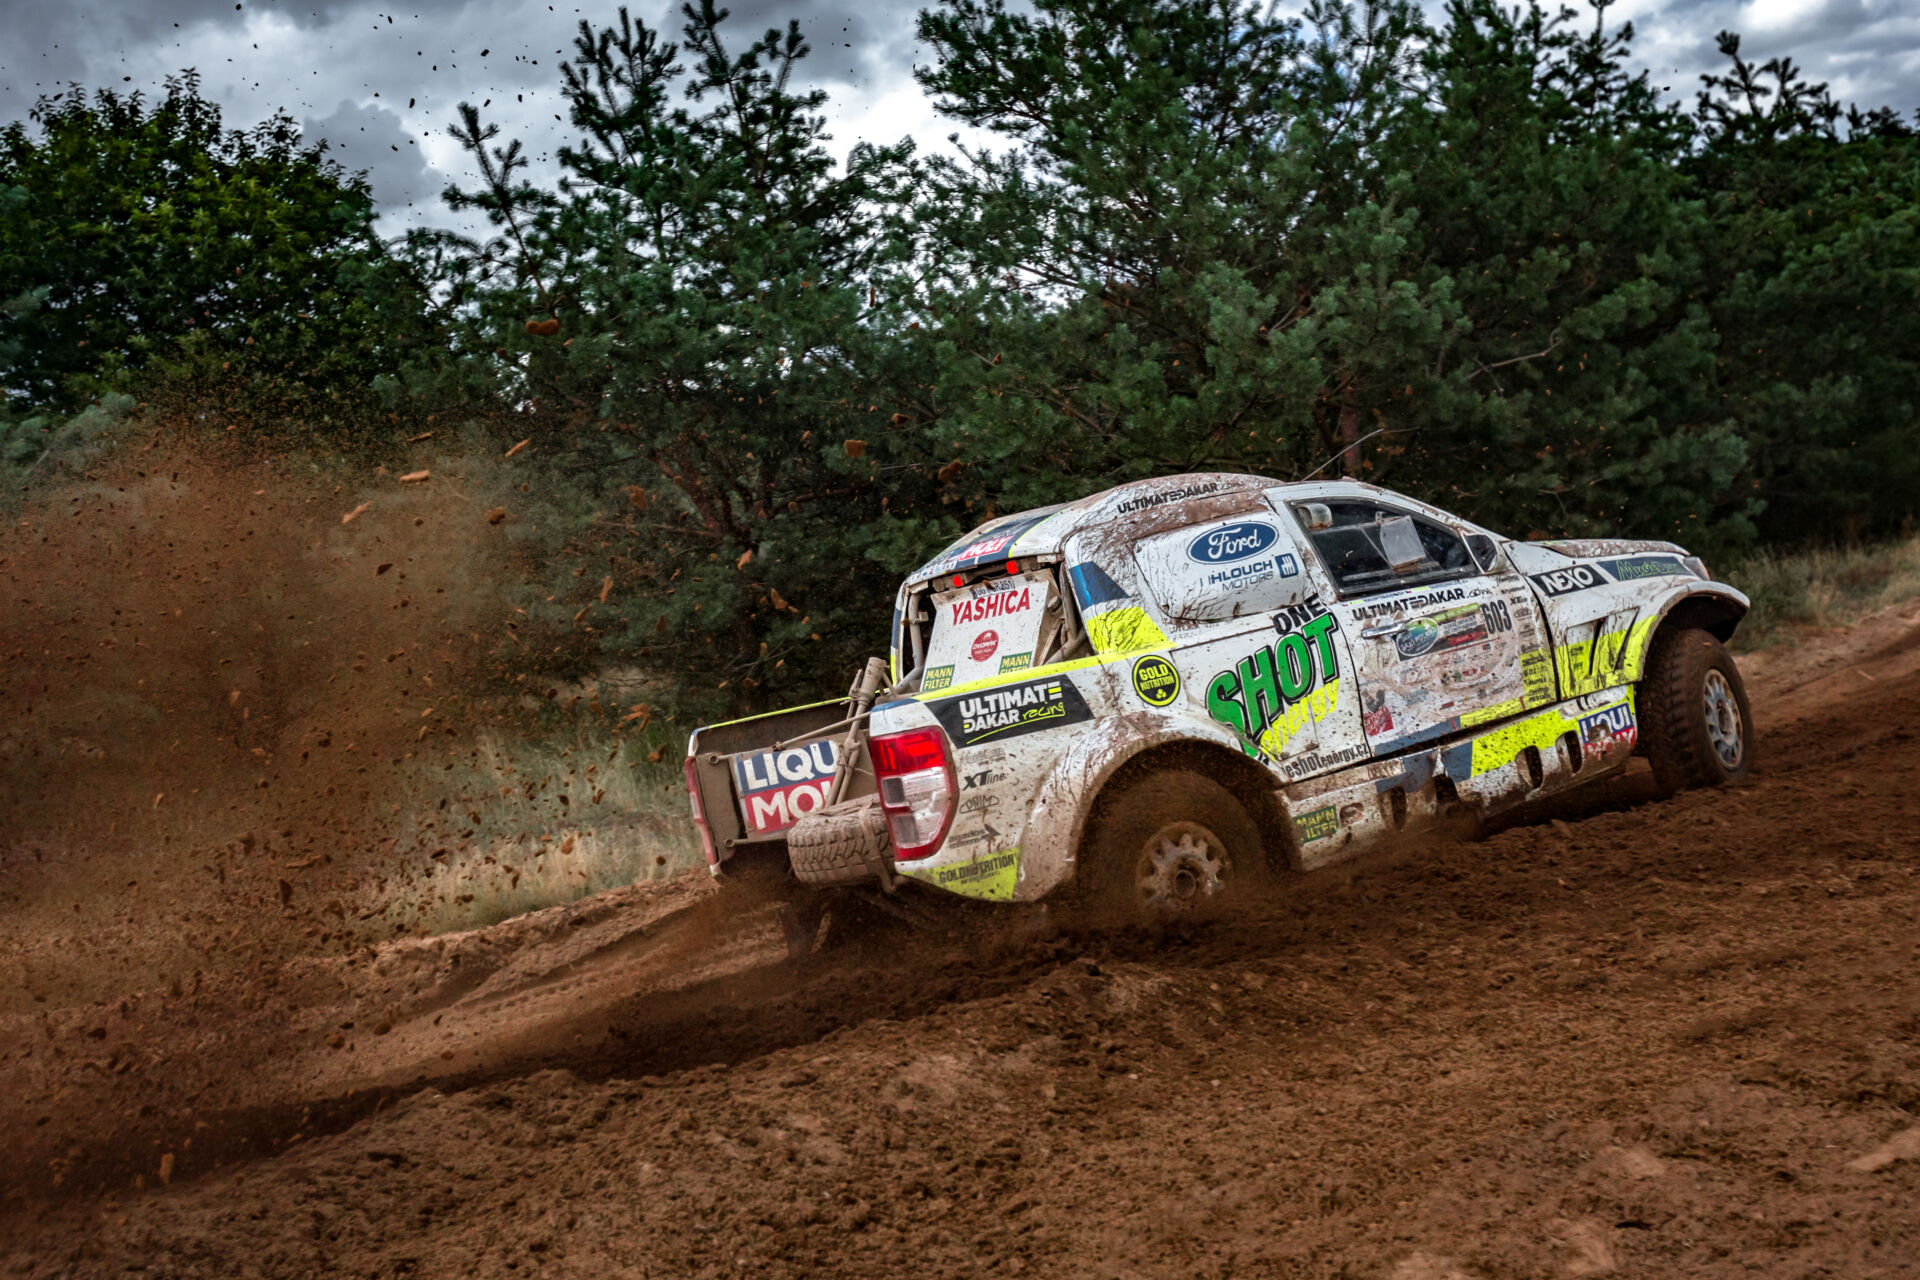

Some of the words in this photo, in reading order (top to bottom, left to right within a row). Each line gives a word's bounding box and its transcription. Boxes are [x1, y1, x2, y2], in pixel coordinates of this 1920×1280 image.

[1207, 527, 1262, 560] Ford
[1222, 570, 1274, 592] MOTORS
[1541, 566, 1594, 594] NEXO
[952, 588, 1031, 627] YASHICA
[1272, 593, 1328, 635] ONE
[1481, 599, 1513, 634] 603
[926, 667, 953, 680] MANN
[1002, 654, 1031, 668] MANN
[1139, 664, 1169, 681] GOLD
[923, 678, 951, 691] FILTER
[1140, 675, 1175, 691] NUTRITION
[1205, 612, 1341, 758] SHOT
[959, 681, 1063, 719] ULTIMATE
[963, 709, 1021, 734] DAKAR
[1022, 701, 1066, 720] racing
[1260, 679, 1340, 763] energy
[743, 740, 840, 790] LIQU
[1300, 822, 1337, 842] ILTER
